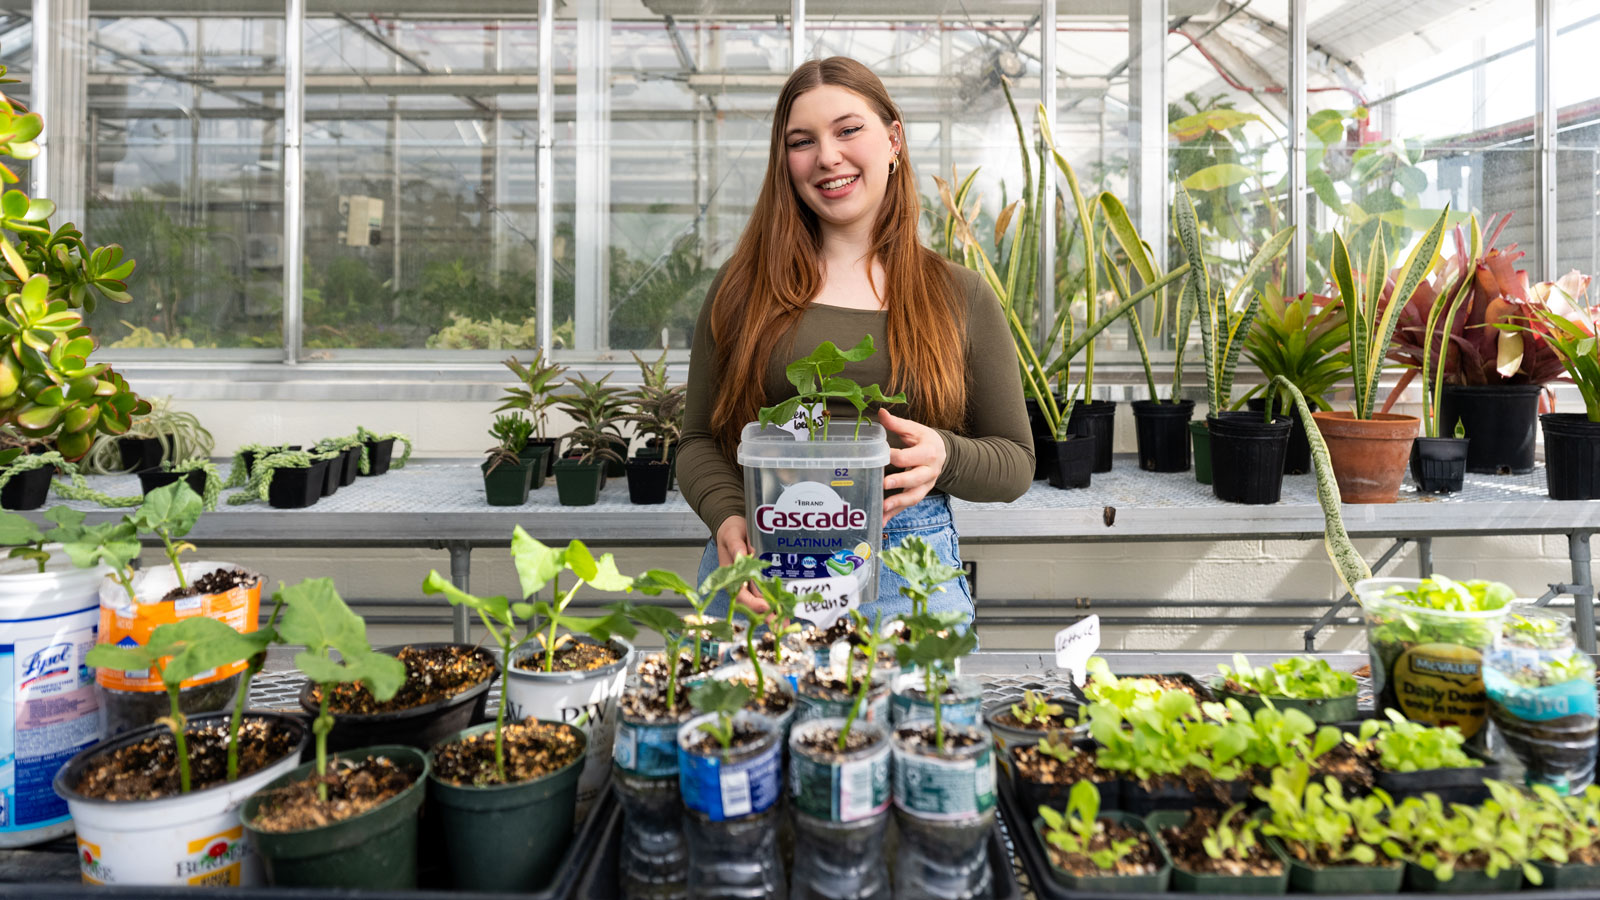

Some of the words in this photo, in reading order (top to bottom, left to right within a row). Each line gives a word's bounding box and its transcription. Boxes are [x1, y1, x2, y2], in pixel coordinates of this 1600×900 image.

[834, 468, 849, 477] 62
[756, 504, 865, 532] Cascade
[777, 537, 842, 548] PLATINUM
[804, 594, 849, 612] beans
[22, 643, 74, 677] Lysol
[1403, 681, 1445, 703] Daily
